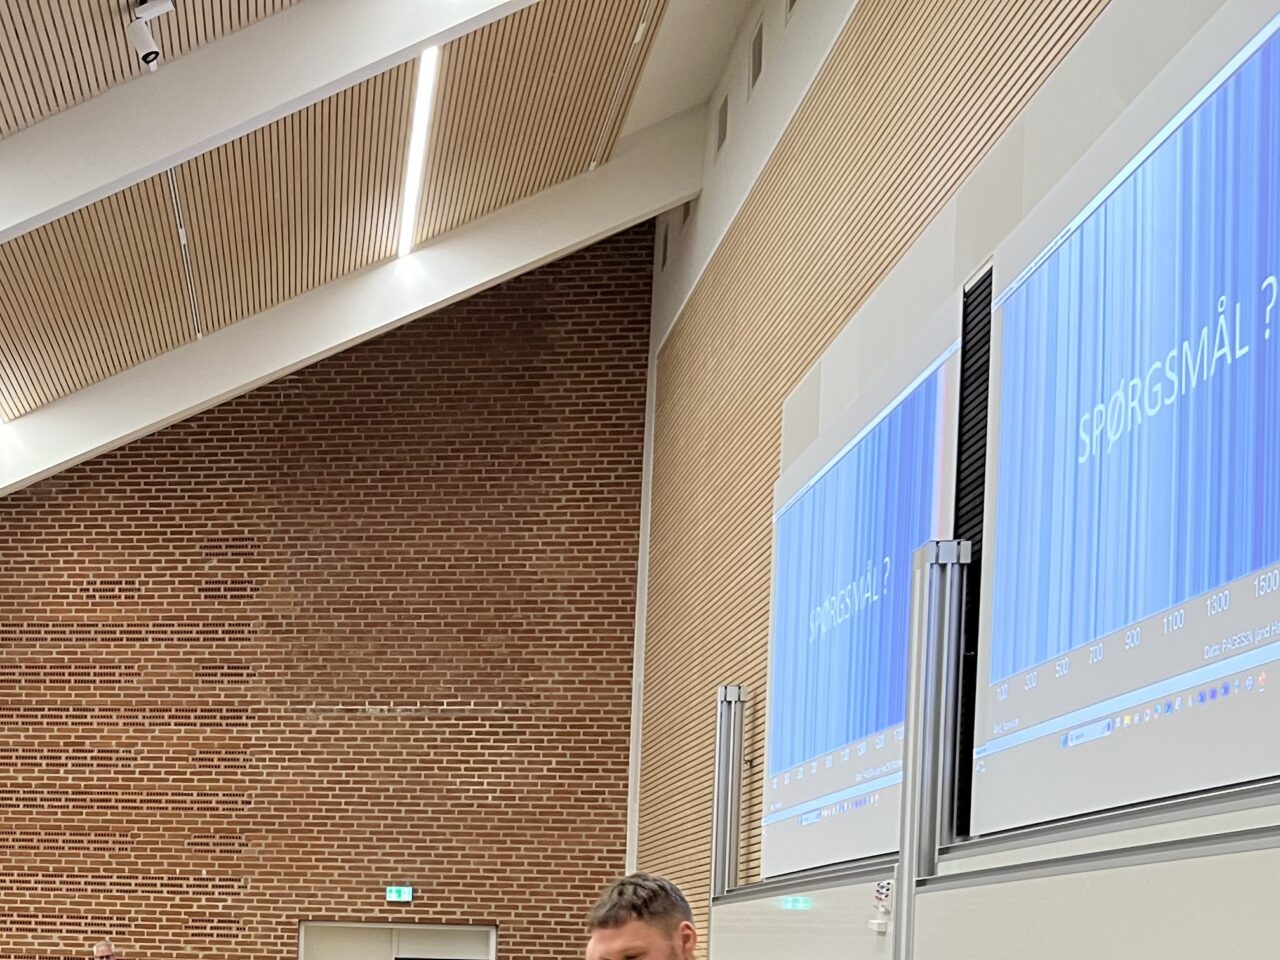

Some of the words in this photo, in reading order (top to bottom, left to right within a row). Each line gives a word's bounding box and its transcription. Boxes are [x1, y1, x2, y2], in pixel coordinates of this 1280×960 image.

[1078, 295, 1249, 464] SPØRGSMÅL
[1261, 275, 1277, 341] ?
[1089, 643, 1104, 664] 700
[1125, 627, 1141, 649] 900
[1163, 609, 1185, 634] 1100
[1206, 590, 1230, 616] 1300
